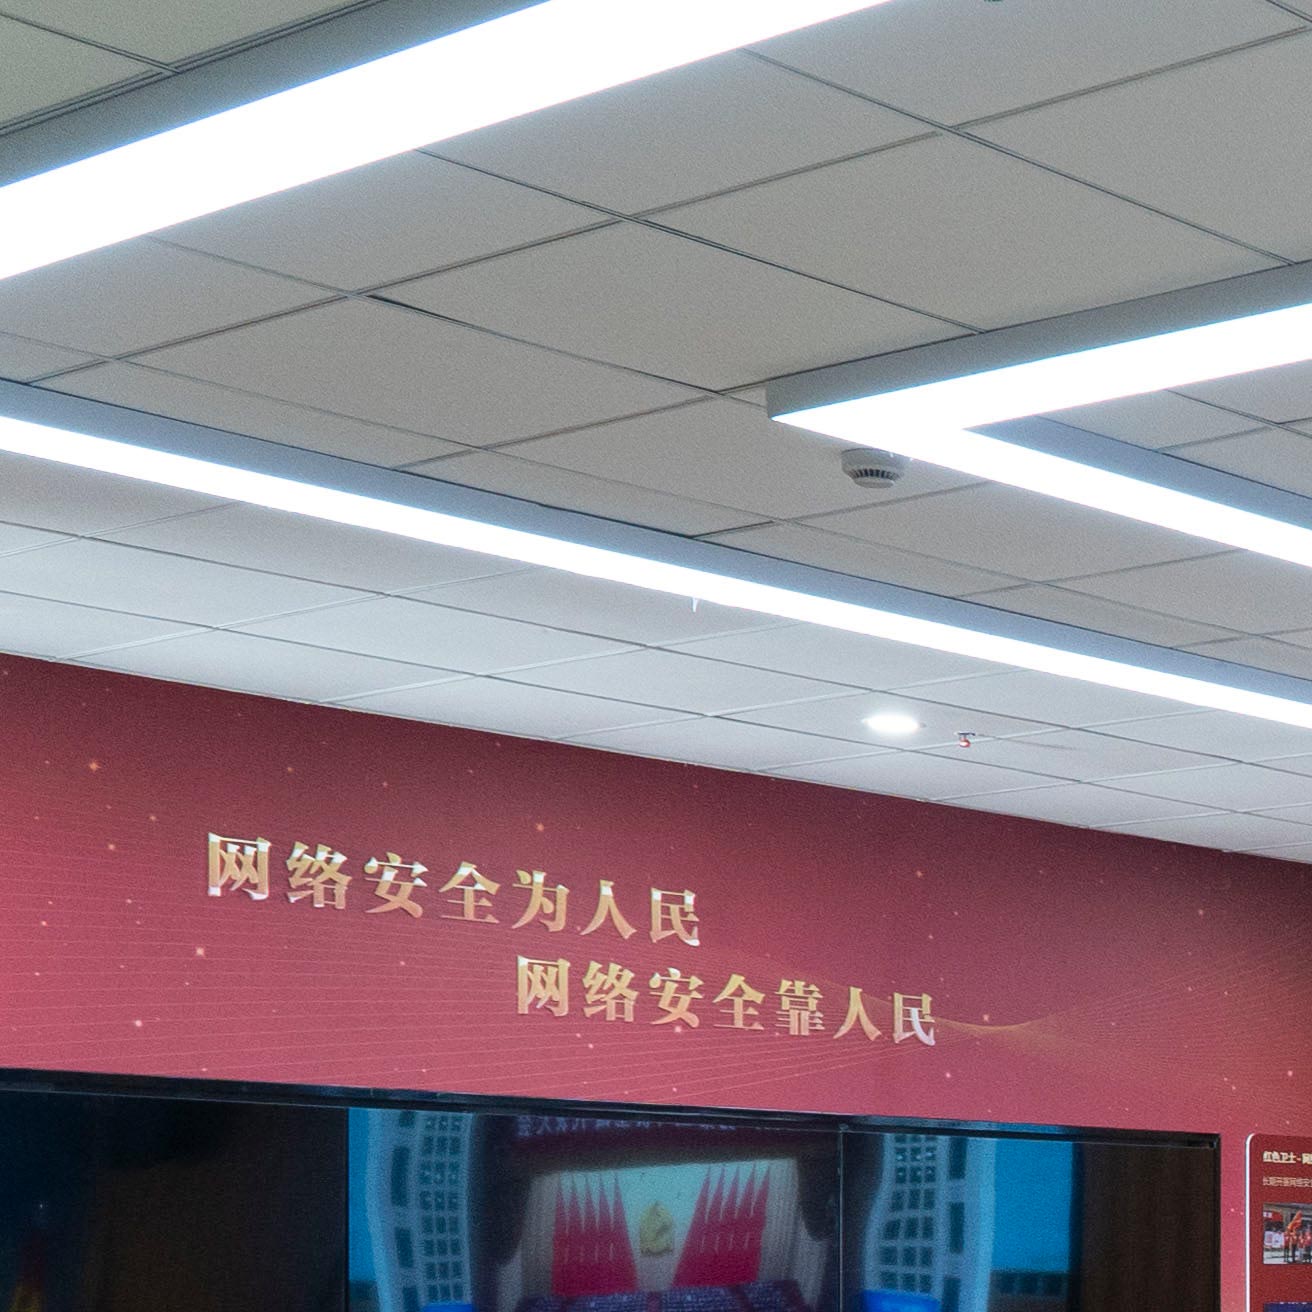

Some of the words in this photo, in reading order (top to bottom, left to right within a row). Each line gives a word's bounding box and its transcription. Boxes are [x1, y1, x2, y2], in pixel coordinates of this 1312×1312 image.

[206, 831, 700, 946] 网络安全为人民
[516, 954, 937, 1046] 网络安全靠人民
